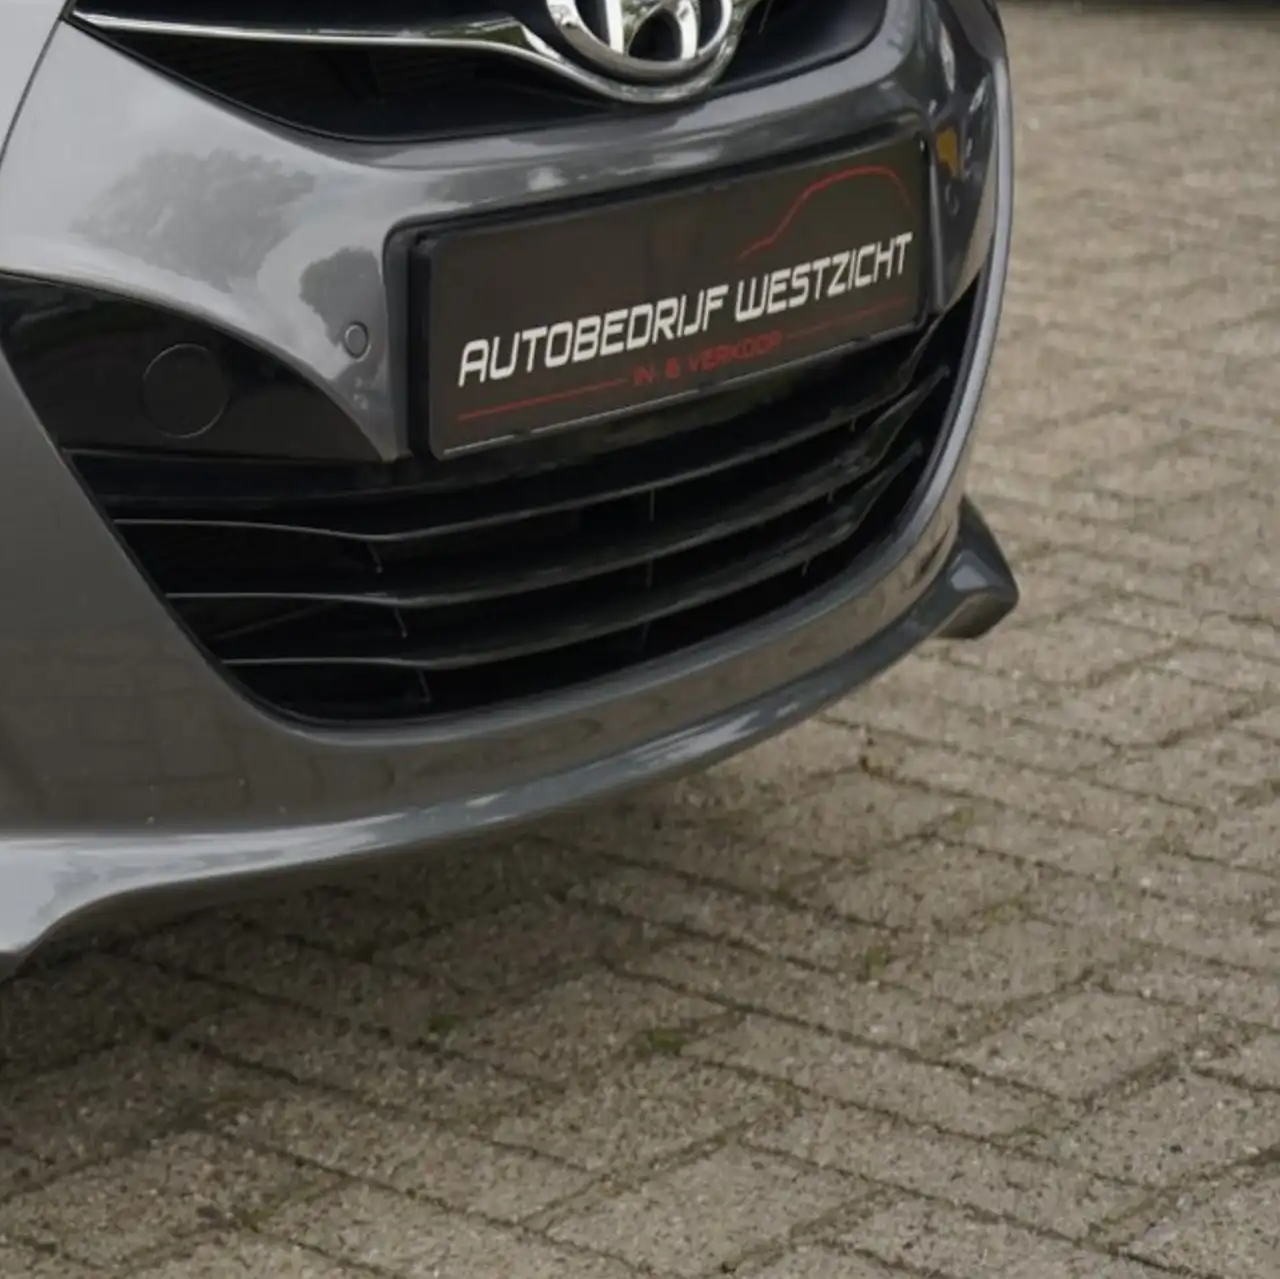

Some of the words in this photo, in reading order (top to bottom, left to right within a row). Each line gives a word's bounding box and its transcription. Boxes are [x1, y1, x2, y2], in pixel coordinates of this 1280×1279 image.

[458, 284, 728, 388] AUTOBEDRIJF
[735, 231, 913, 322] WESTZICHT
[689, 329, 783, 372] VERKOOP
